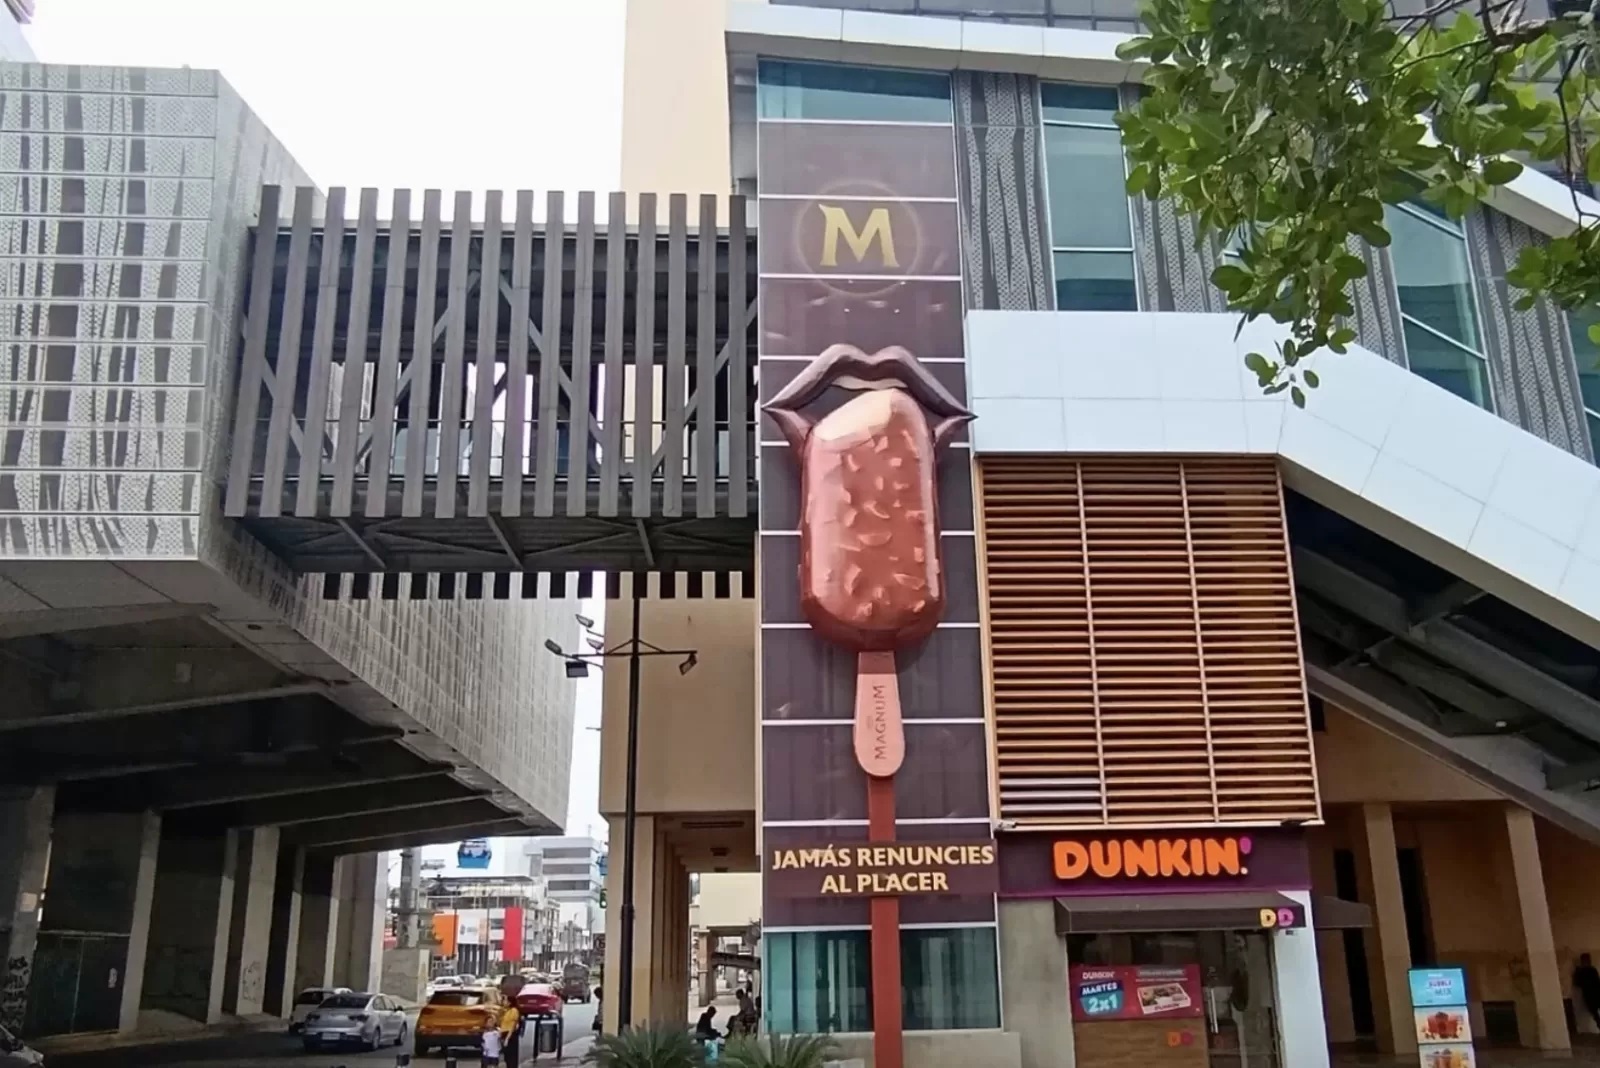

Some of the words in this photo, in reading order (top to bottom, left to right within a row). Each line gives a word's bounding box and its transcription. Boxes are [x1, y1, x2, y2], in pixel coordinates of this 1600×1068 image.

[818, 203, 900, 268] M
[872, 684, 888, 760] MAGNUM
[772, 844, 851, 870] JAMÁS
[857, 845, 995, 867] RENUNCIES
[821, 875, 852, 893] AL
[857, 872, 948, 892] PLACER
[1082, 982, 1118, 996] MARTES
